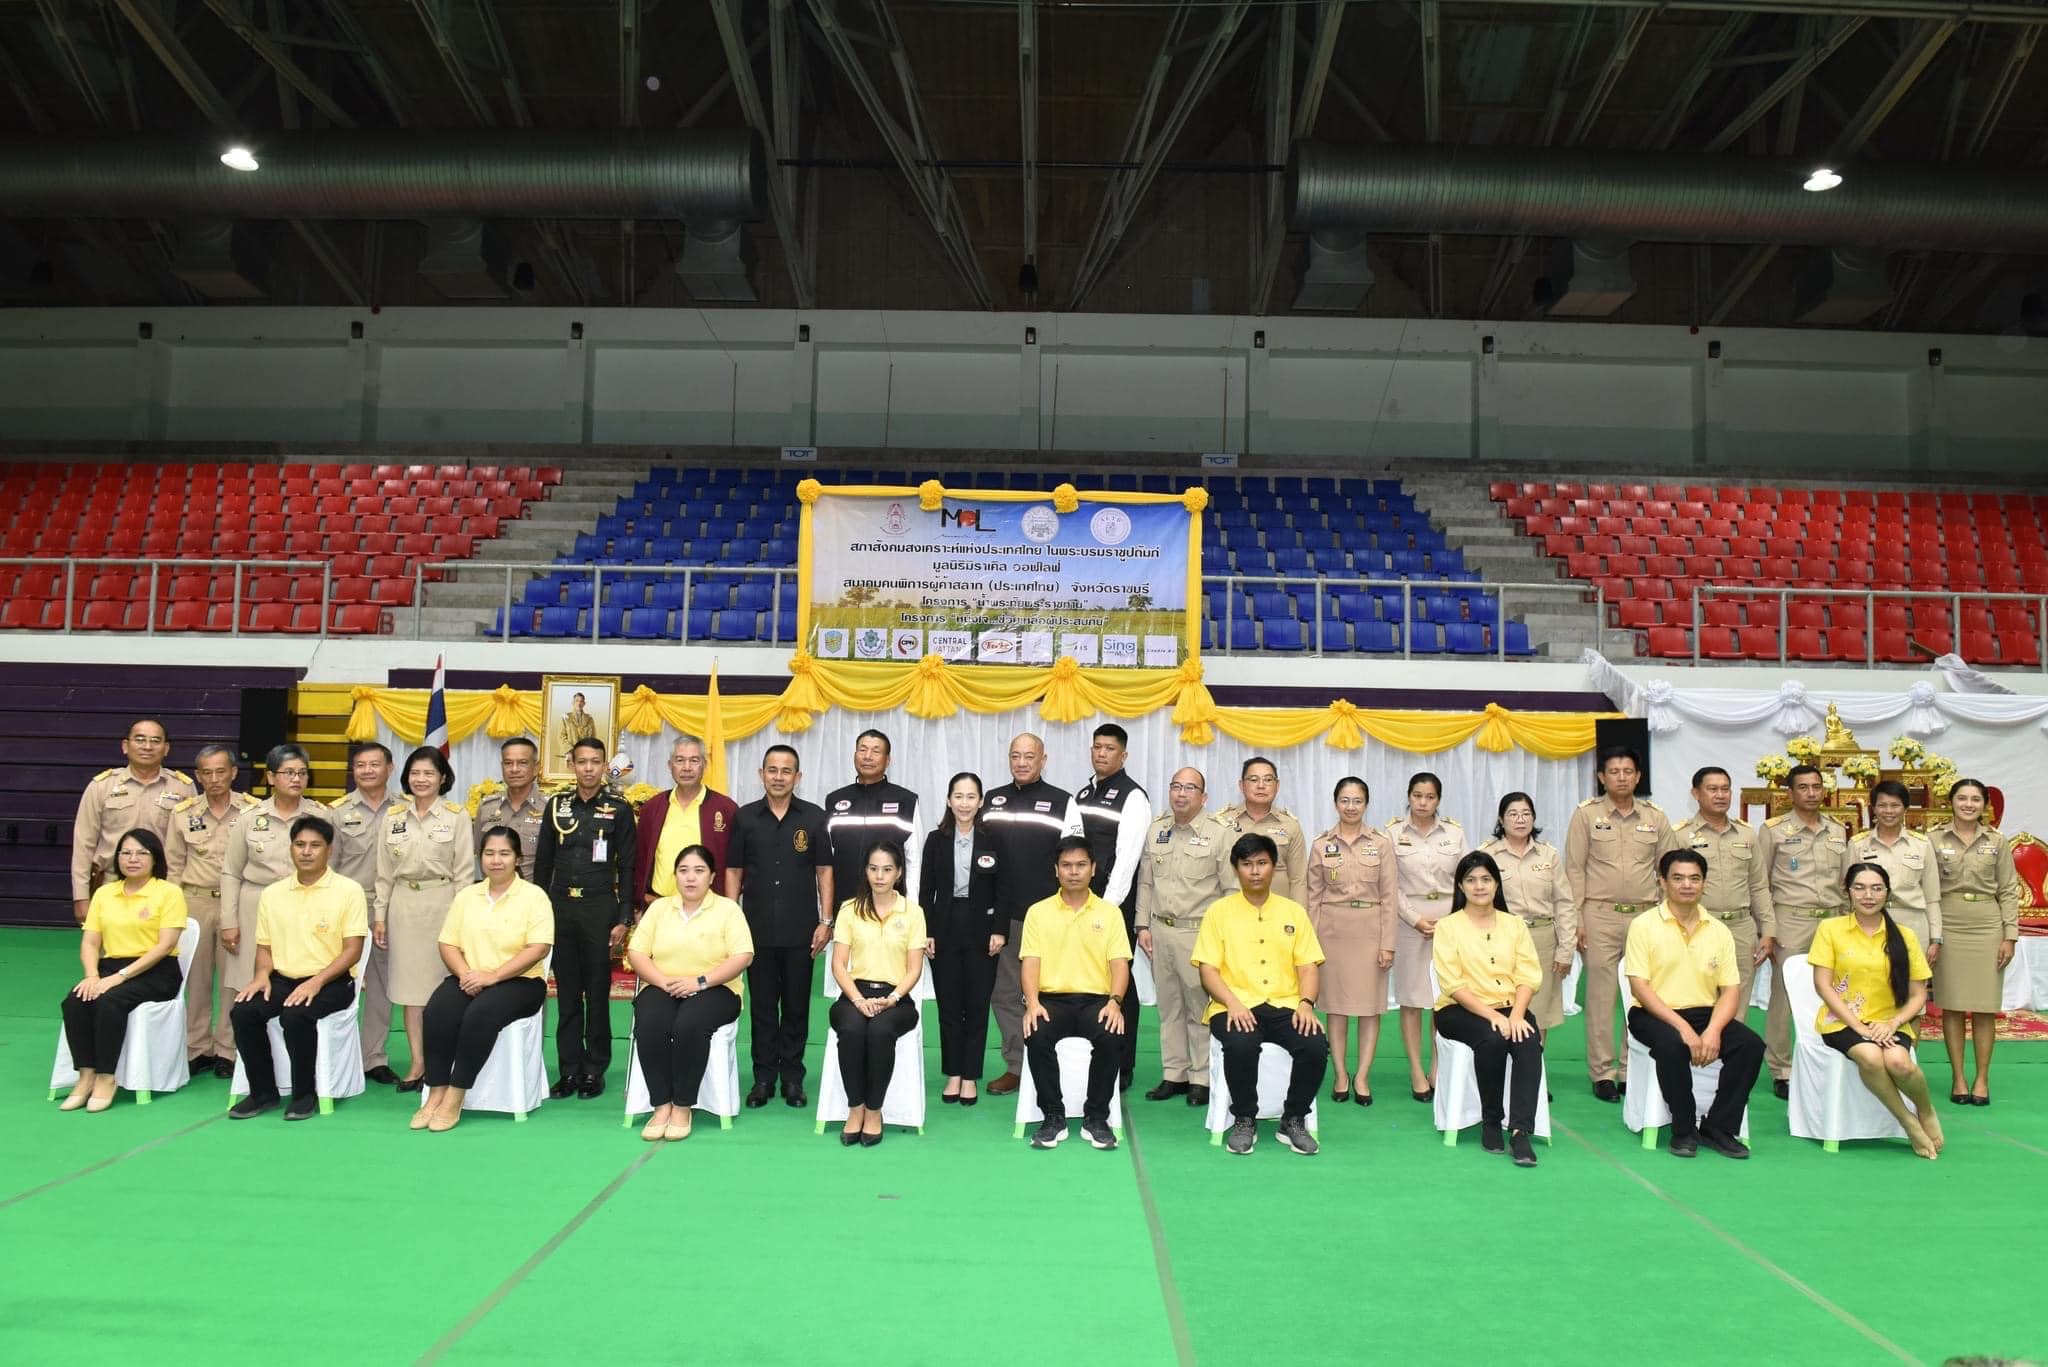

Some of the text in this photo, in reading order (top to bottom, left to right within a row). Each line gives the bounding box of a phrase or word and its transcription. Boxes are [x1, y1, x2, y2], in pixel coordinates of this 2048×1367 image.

[784, 449, 814, 457] TOT
[850, 539, 1041, 556] สภาสังคมสงเคราะห์แห่งประเทศไทย
[989, 580, 1060, 592] (ประเทศไทย)
[1071, 581, 1150, 597] จังหวัดราชบุรี
[922, 596, 967, 607] โครงการ
[901, 612, 946, 623] โครงการ
[933, 636, 967, 645] CENTRAL
